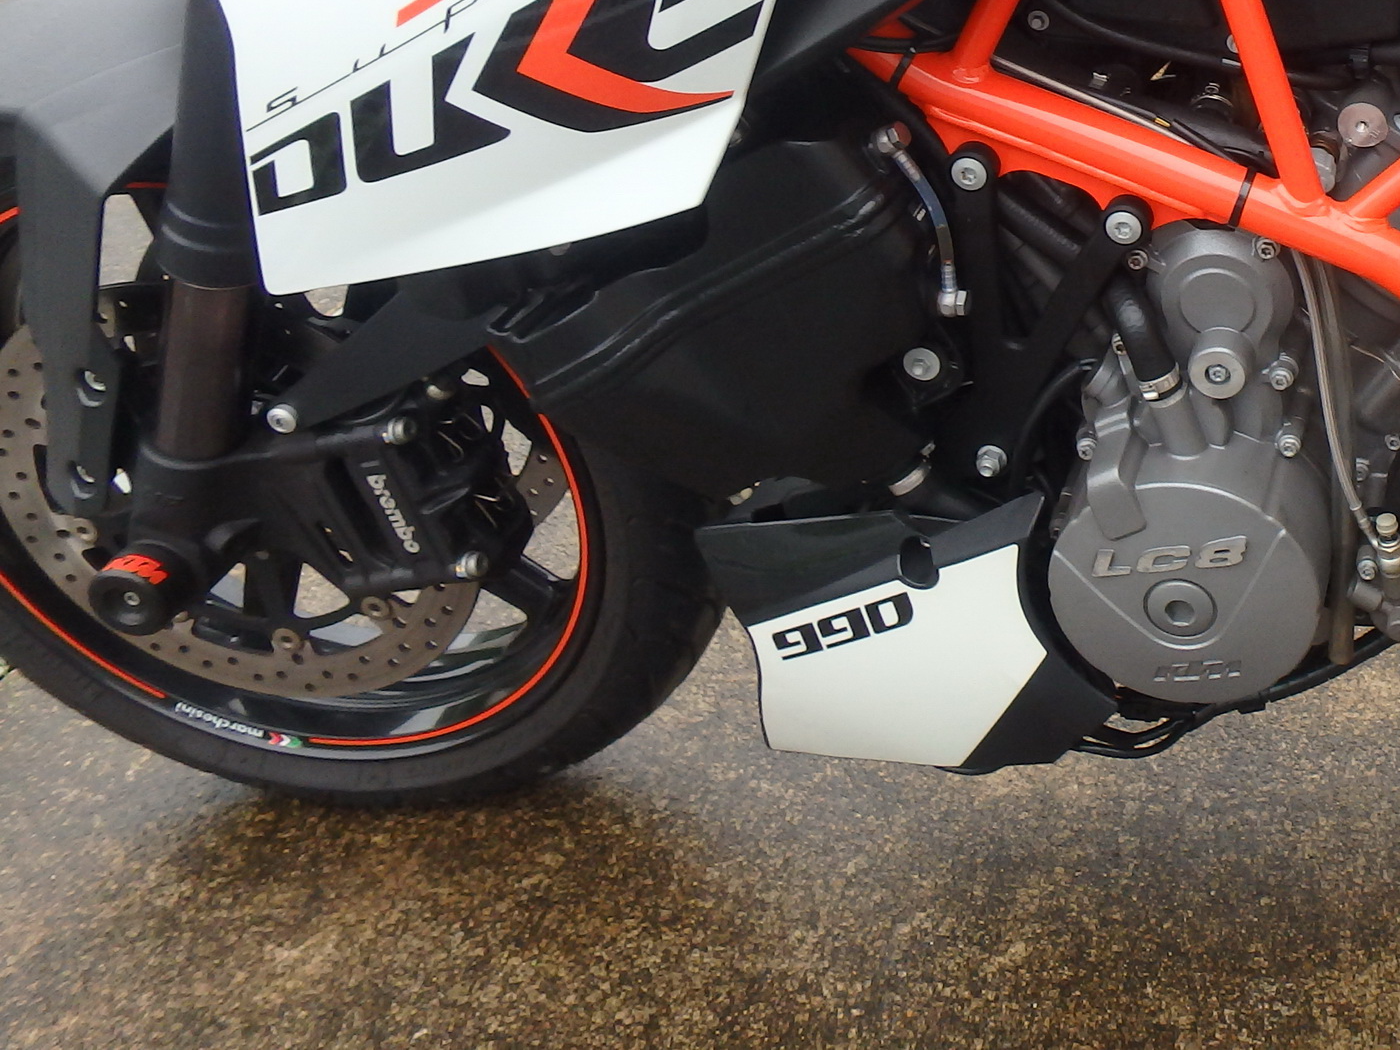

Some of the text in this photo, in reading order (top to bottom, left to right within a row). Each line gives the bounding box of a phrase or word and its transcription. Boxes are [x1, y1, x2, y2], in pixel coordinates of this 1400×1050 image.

[366, 474, 420, 553] brembo
[1091, 535, 1249, 578] LC8
[771, 592, 914, 661] 990
[174, 701, 265, 738] marchesini
